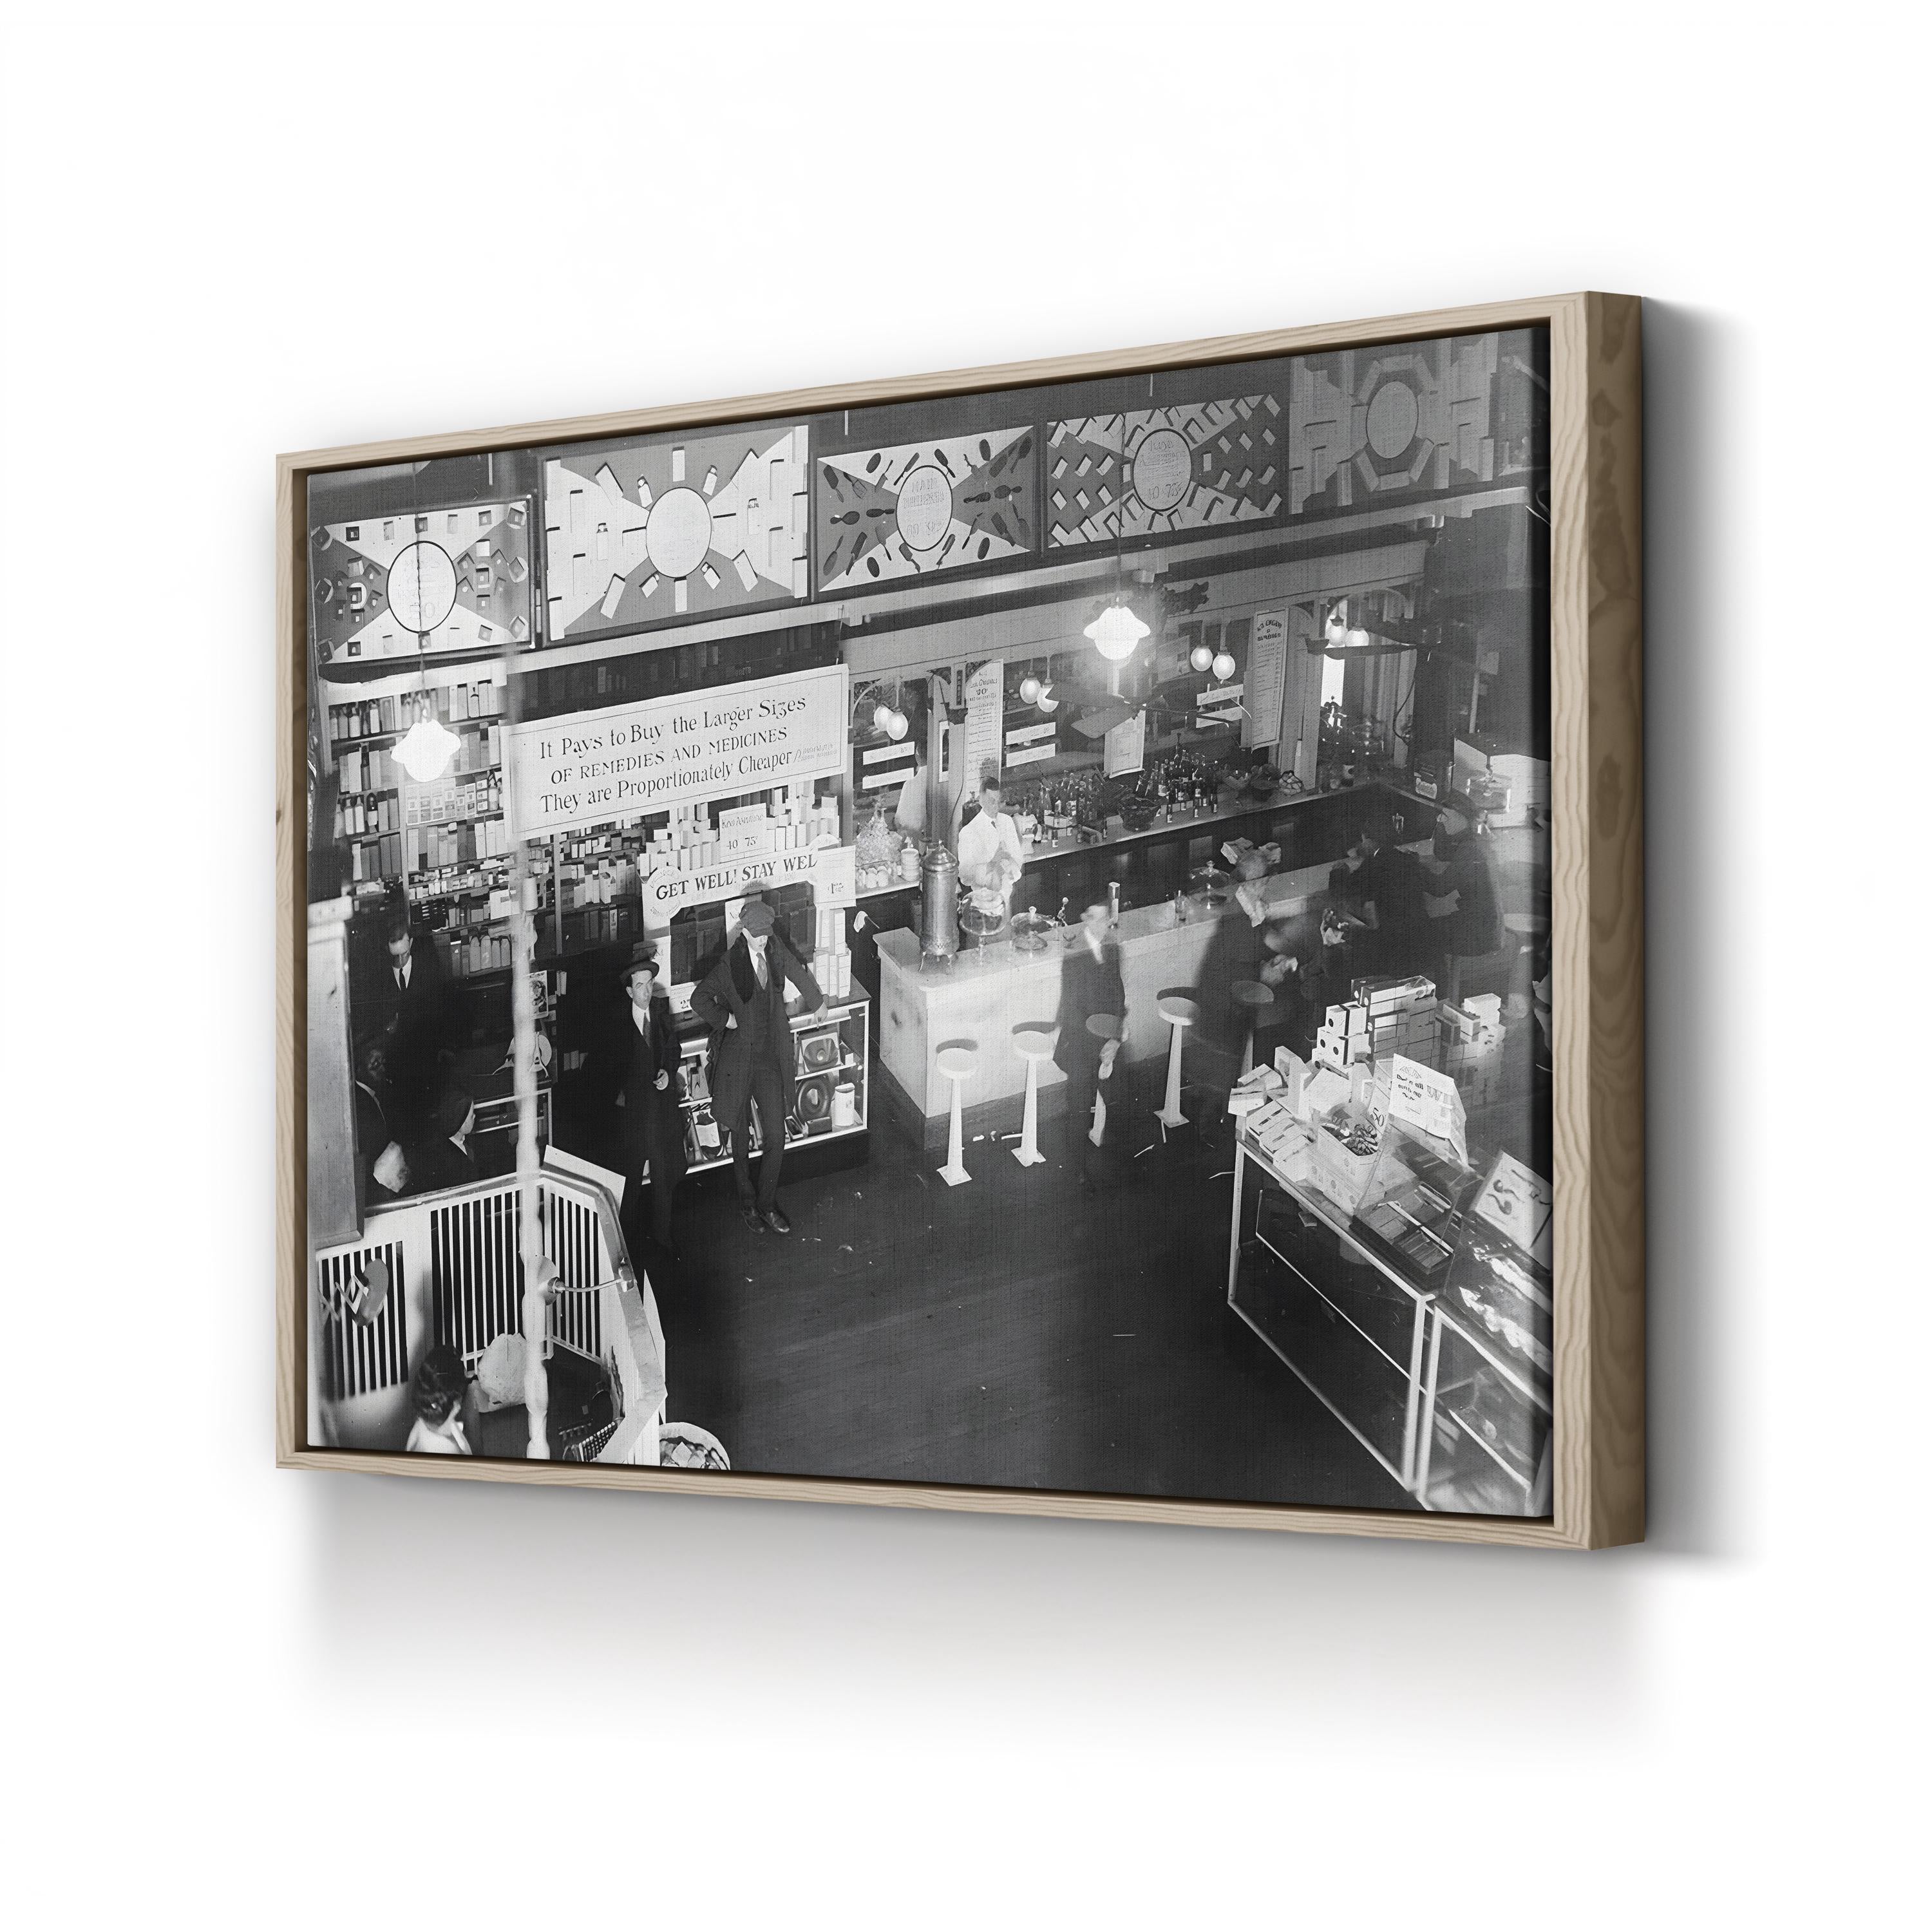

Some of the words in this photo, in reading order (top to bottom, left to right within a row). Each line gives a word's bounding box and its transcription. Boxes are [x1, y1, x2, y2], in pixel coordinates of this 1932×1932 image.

[540, 741, 553, 759] It
[562, 736, 603, 759] Pays
[611, 728, 626, 746] to
[630, 724, 664, 744] Buy
[673, 716, 697, 734] the
[704, 706, 753, 731] Larger
[759, 697, 806, 719] Sizes
[551, 768, 573, 784] OF
[580, 750, 665, 779] REMEDIES
[671, 744, 701, 762] AND
[708, 726, 787, 755] MEDICINES
[540, 793, 582, 814] They
[587, 787, 612, 804] are
[618, 761, 733, 799] Proportionately
[739, 751, 792, 774] Cheaper
[656, 880, 689, 900] GET
[695, 869, 737, 891] WELL!
[741, 861, 777, 882] STAY
